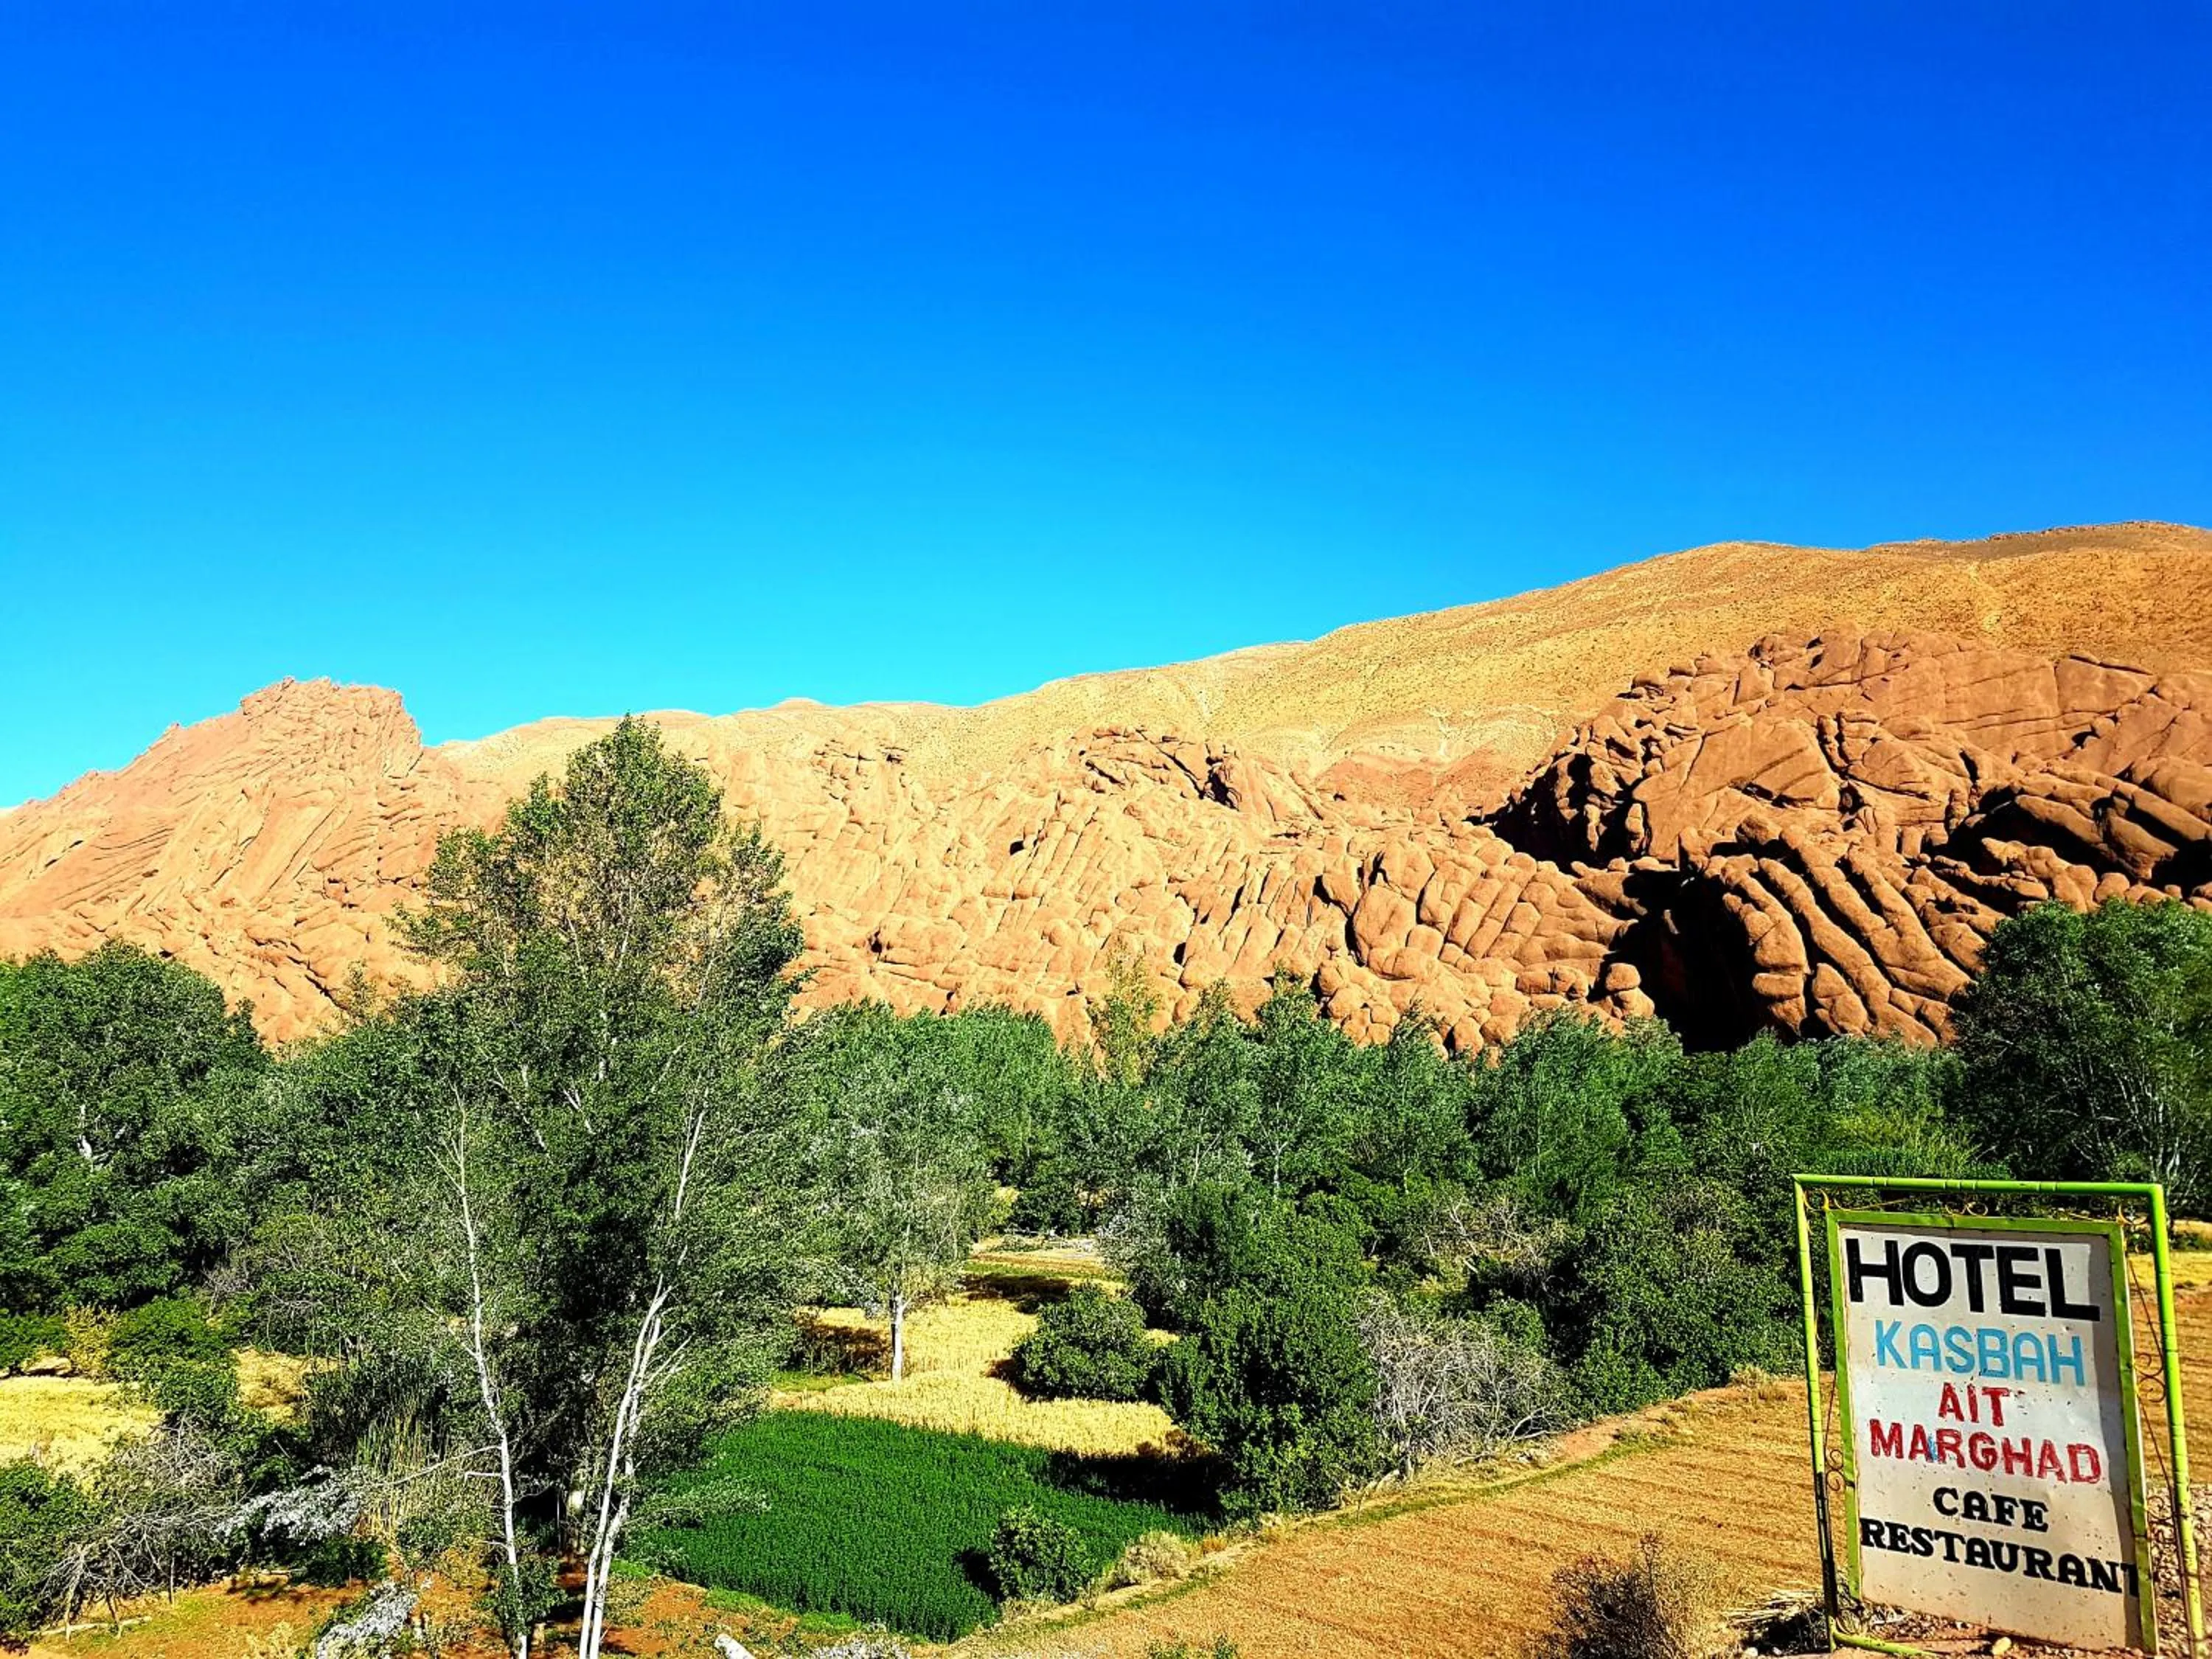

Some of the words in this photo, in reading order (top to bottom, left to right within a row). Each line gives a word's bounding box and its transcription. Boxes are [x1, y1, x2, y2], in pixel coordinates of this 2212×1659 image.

[1846, 1239, 2100, 1321] HOTEL
[1875, 1320, 2085, 1386] KASBAH
[1938, 1383, 2010, 1426] AIT
[1870, 1419, 2101, 1484] MARGHAD
[1933, 1487, 2048, 1532] CAFE
